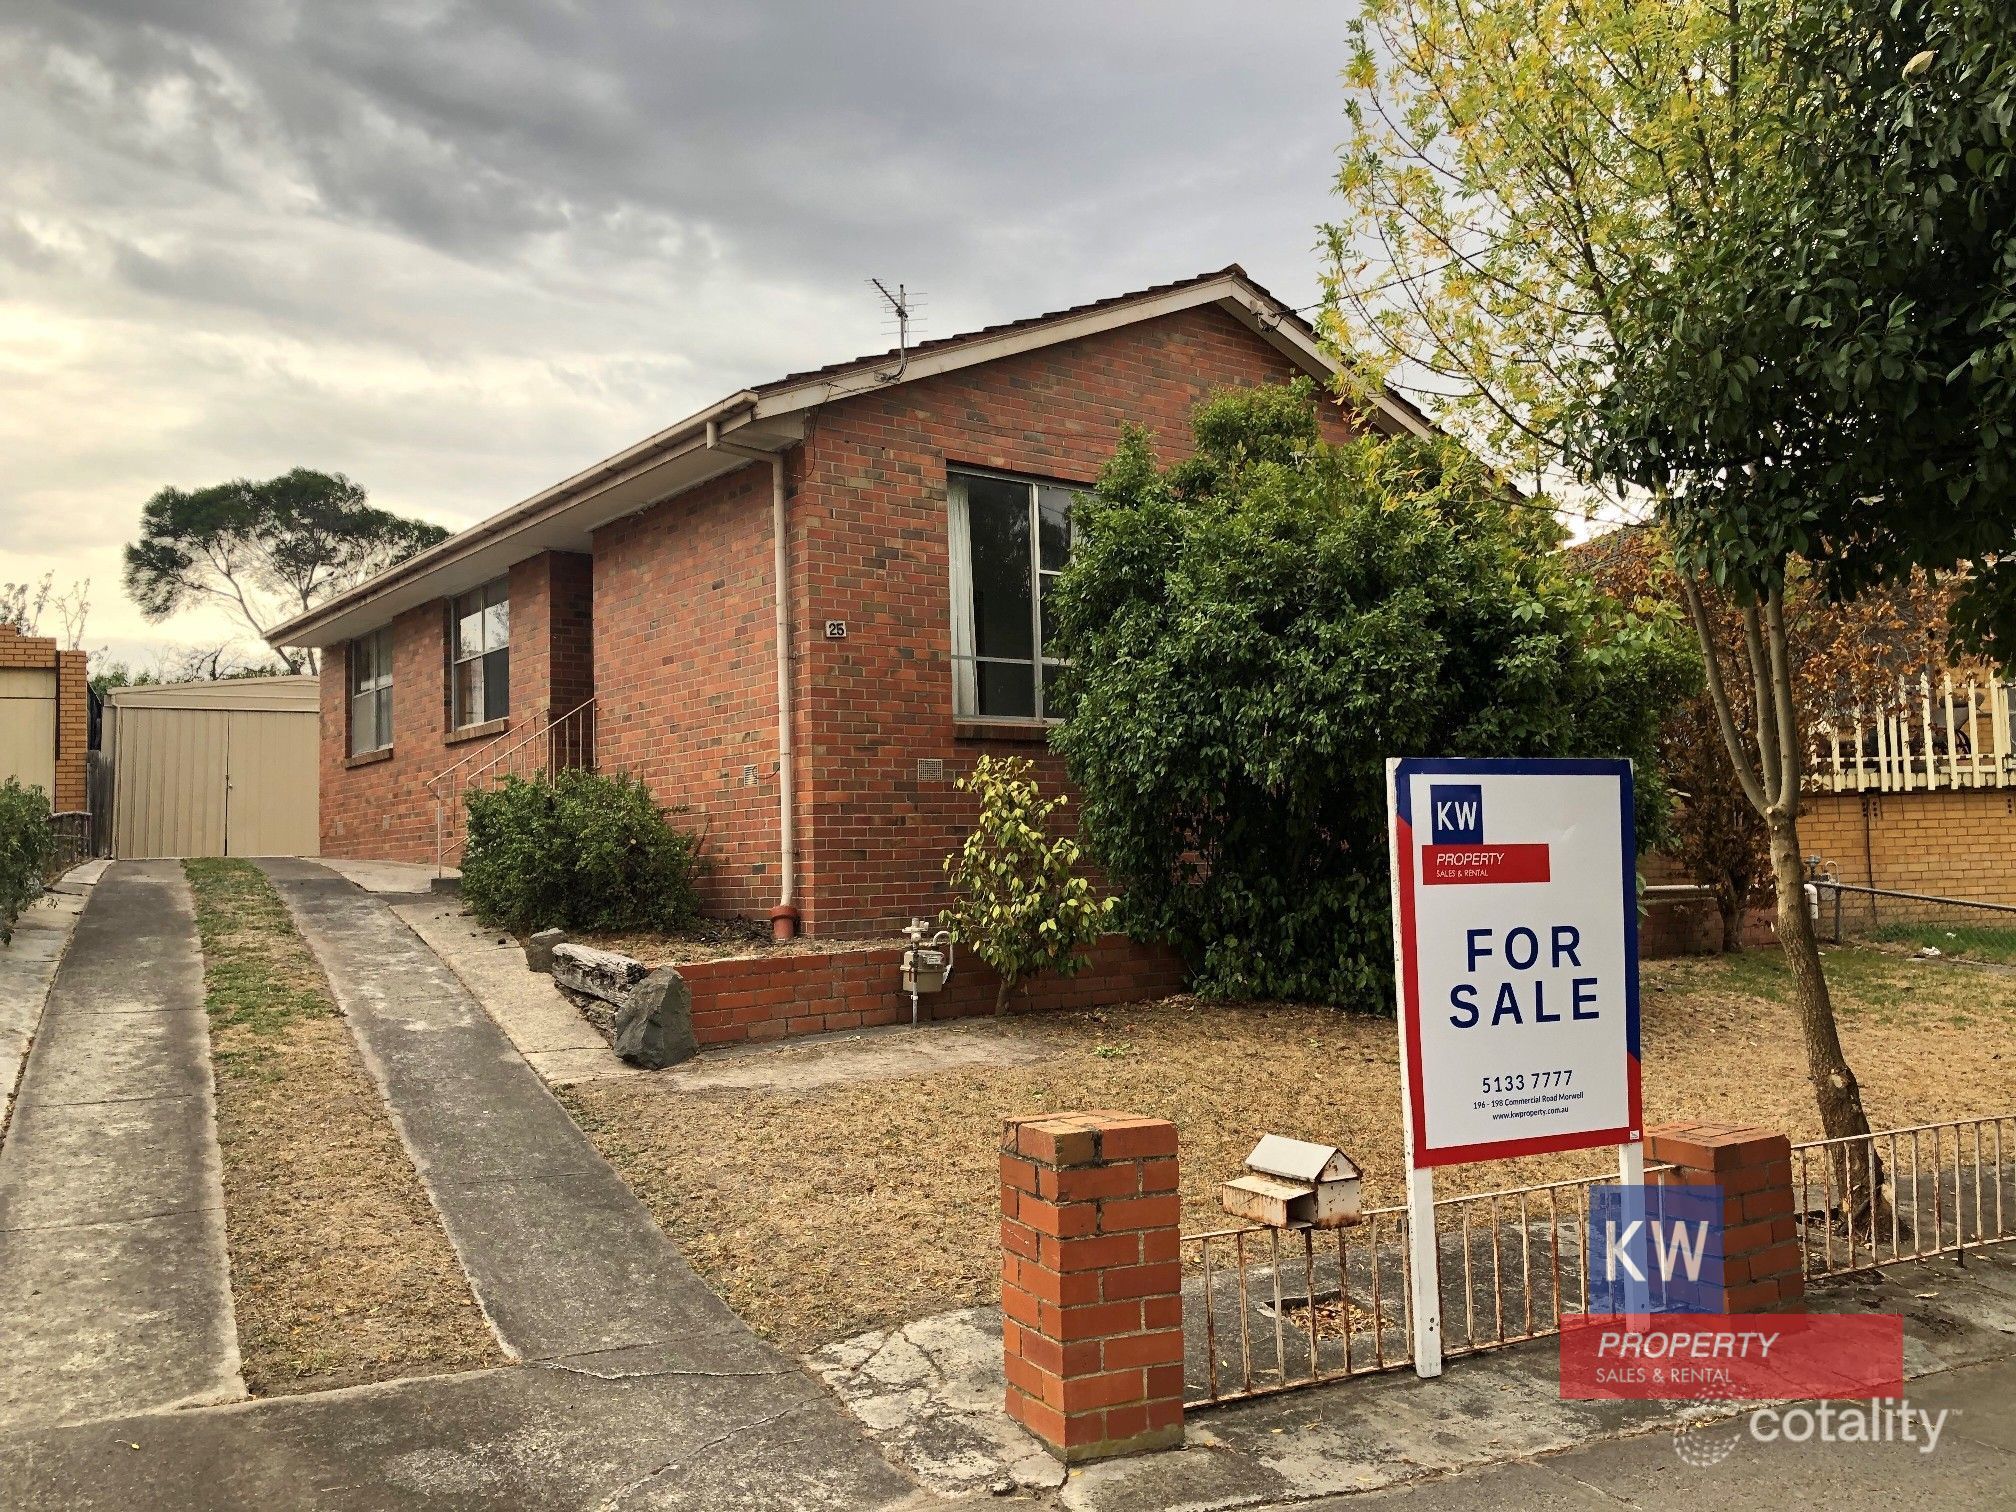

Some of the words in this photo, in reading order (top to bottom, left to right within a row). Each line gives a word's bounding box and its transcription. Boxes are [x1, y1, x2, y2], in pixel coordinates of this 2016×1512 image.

[829, 622, 845, 636] 25
[1437, 801, 1477, 831] KW
[1436, 852, 1505, 866] PROPERTY
[1436, 869, 1456, 878] SALES
[1464, 869, 1489, 877] RENTAL
[1467, 925, 1581, 972] FOR
[1450, 977, 1600, 1029] SALE
[1482, 1074, 1525, 1094] 5133
[1531, 1069, 1573, 1089] 7777
[1473, 1101, 1486, 1110] 196
[1491, 1099, 1504, 1108] 198
[1504, 1095, 1541, 1107] Commercial
[1542, 1093, 1558, 1103] Road
[1558, 1091, 1584, 1102] Morwell
[1492, 1106, 1569, 1121] www.kwproperty.com.au
